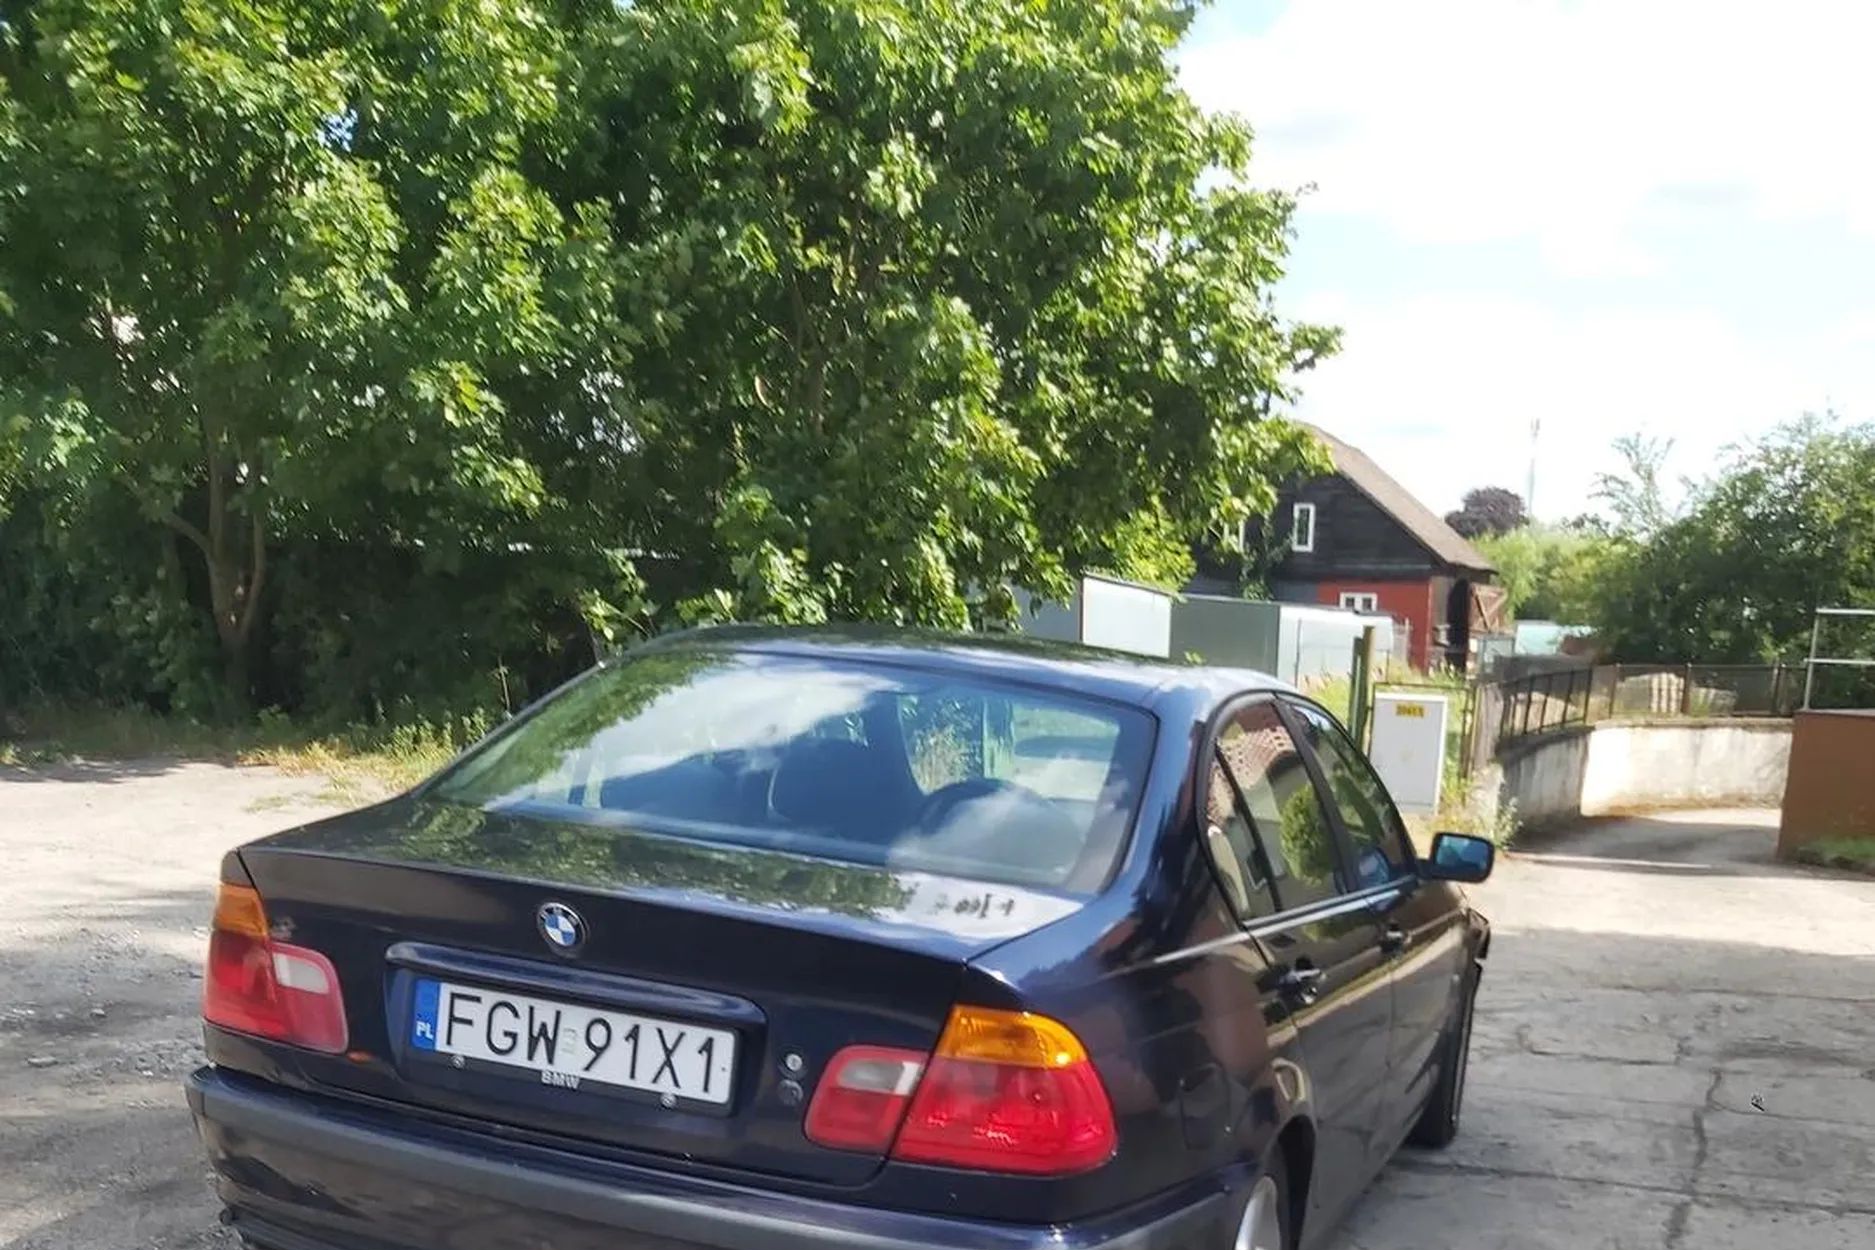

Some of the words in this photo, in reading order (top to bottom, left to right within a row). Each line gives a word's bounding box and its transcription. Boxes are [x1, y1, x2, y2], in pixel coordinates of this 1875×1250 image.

[416, 1020, 434, 1039] PL
[446, 992, 561, 1066] FGW
[583, 1017, 715, 1093] 91X1
